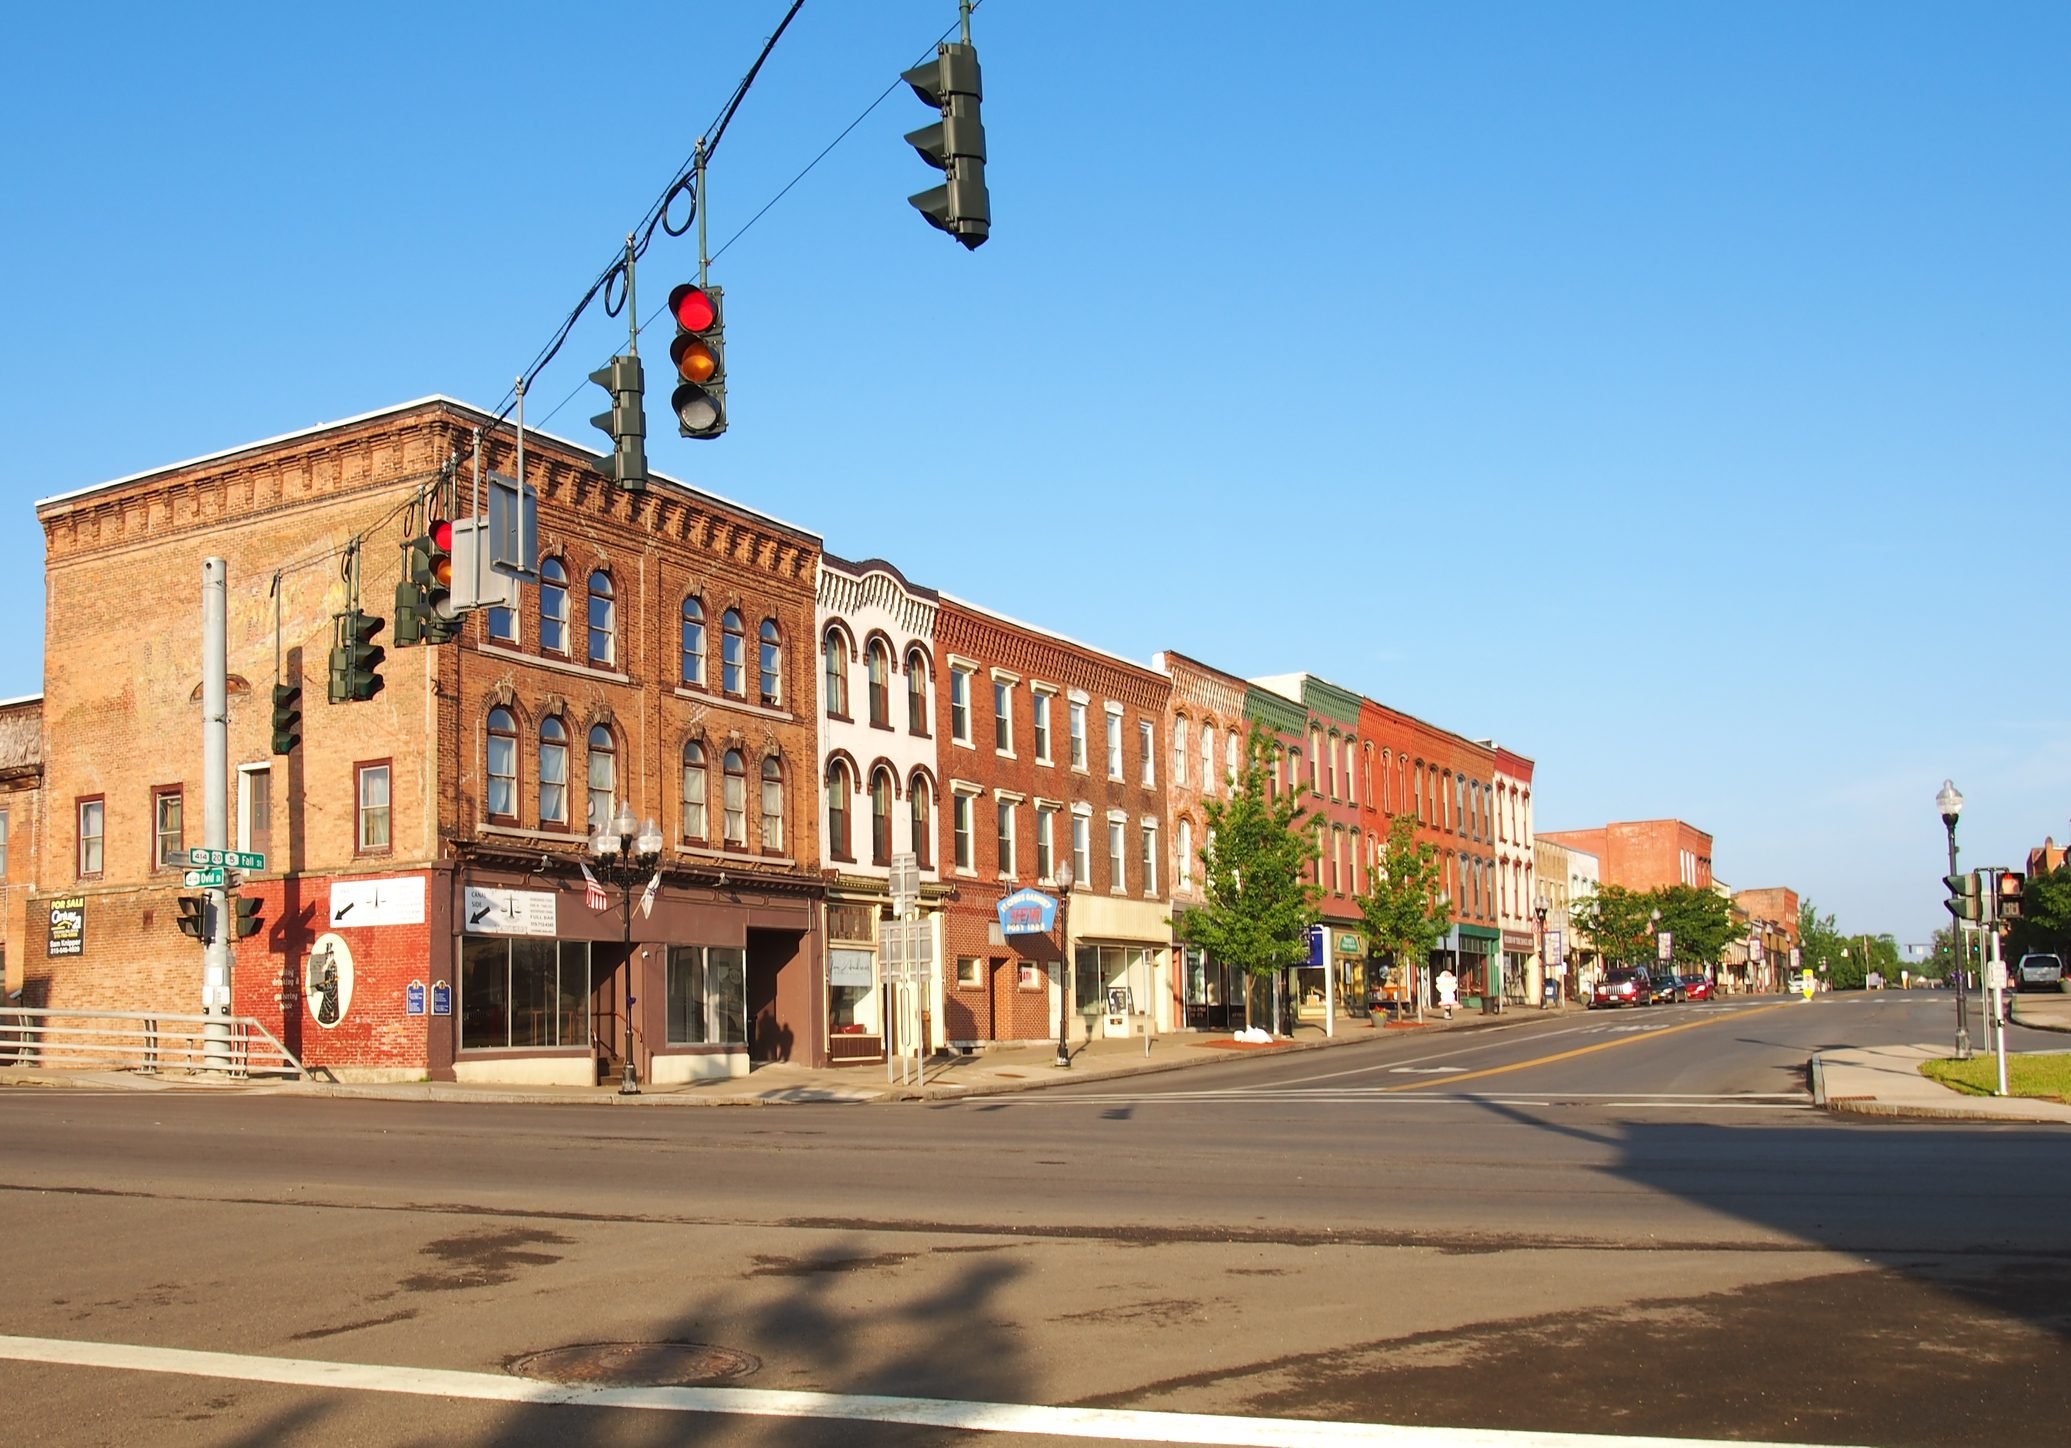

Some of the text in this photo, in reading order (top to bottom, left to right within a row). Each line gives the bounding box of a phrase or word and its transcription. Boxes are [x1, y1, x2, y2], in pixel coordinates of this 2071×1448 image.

[242, 856, 254, 866] Fall
[201, 872, 214, 883] Ovid
[51, 898, 83, 910] FOR SALE
